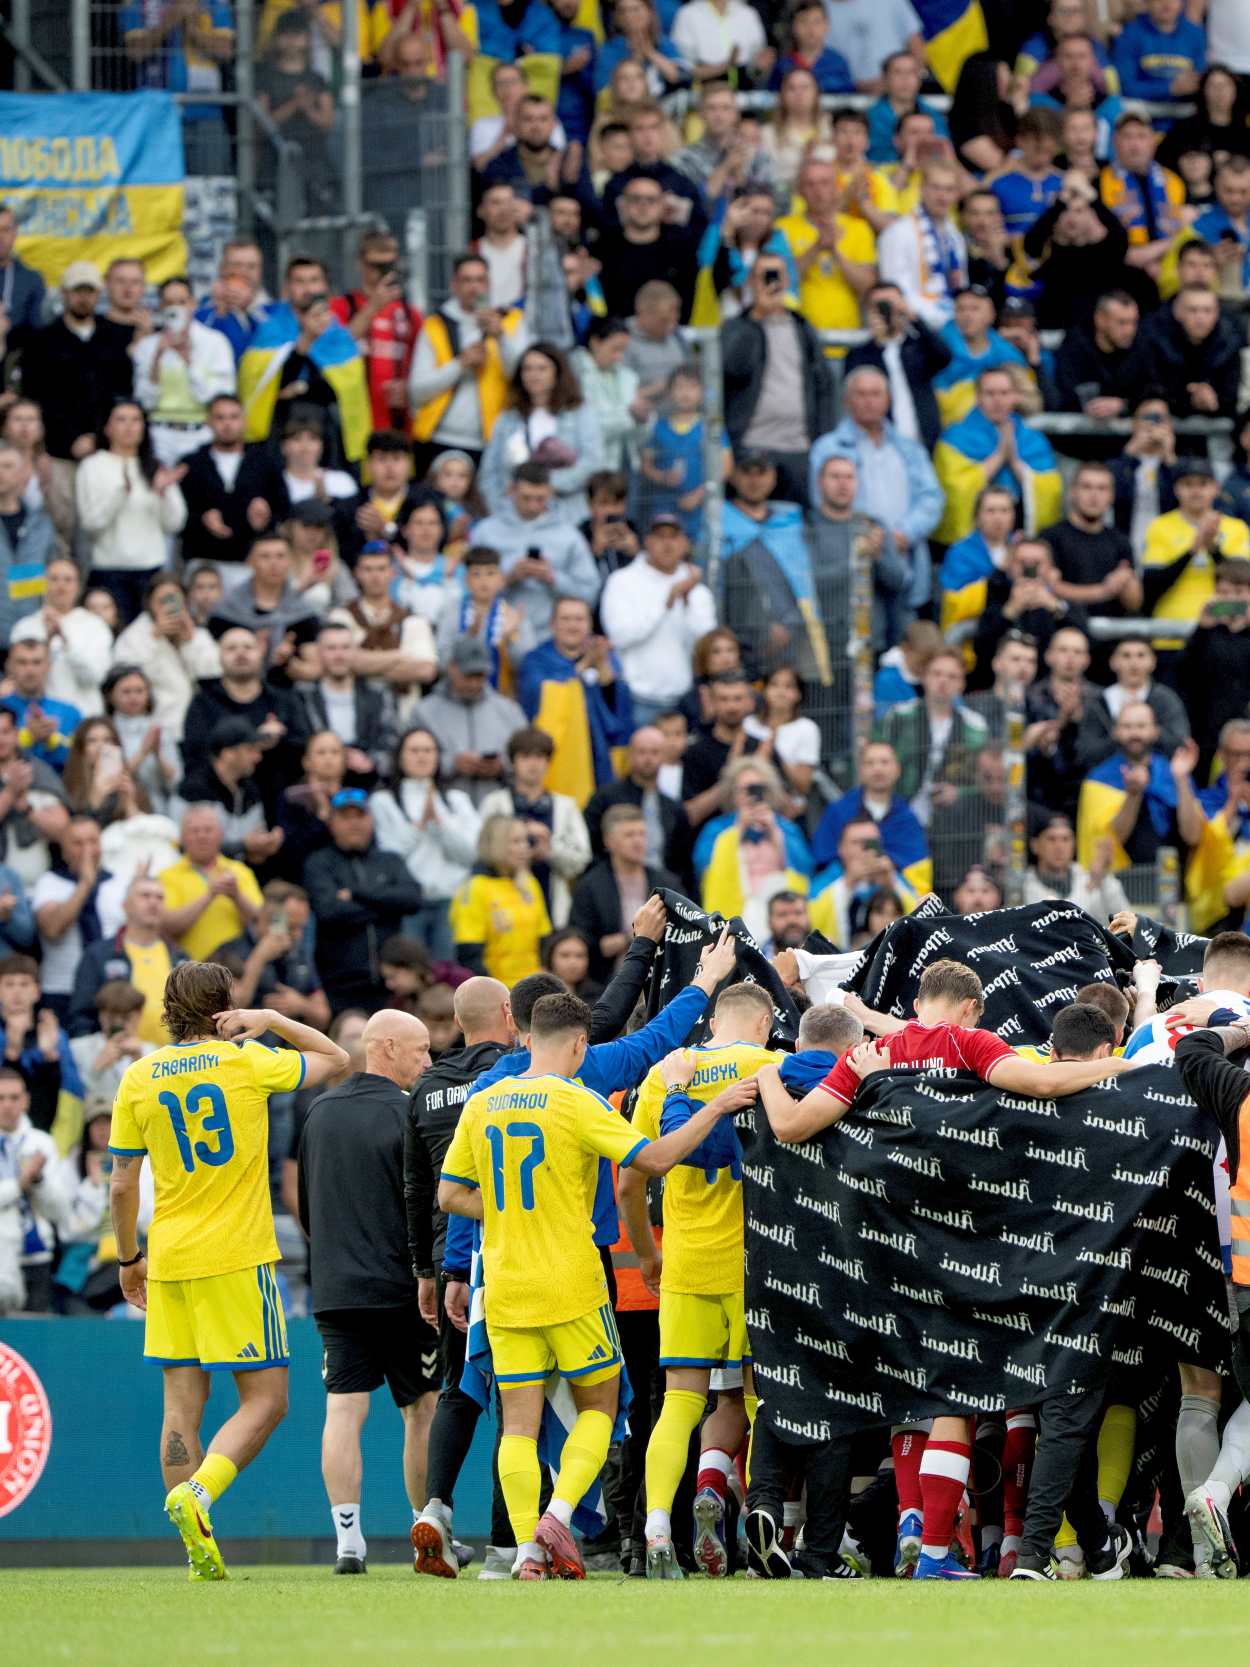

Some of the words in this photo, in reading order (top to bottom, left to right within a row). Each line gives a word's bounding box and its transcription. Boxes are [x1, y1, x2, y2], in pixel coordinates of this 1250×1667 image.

[908, 927, 955, 981] Albani
[966, 933, 1021, 962] Albani
[1031, 942, 1085, 974] Albani
[151, 1054, 219, 1079] ZABARNYI
[426, 1090, 444, 1111] FOR
[159, 1083, 234, 1173] 13
[485, 1122, 545, 1212] 17
